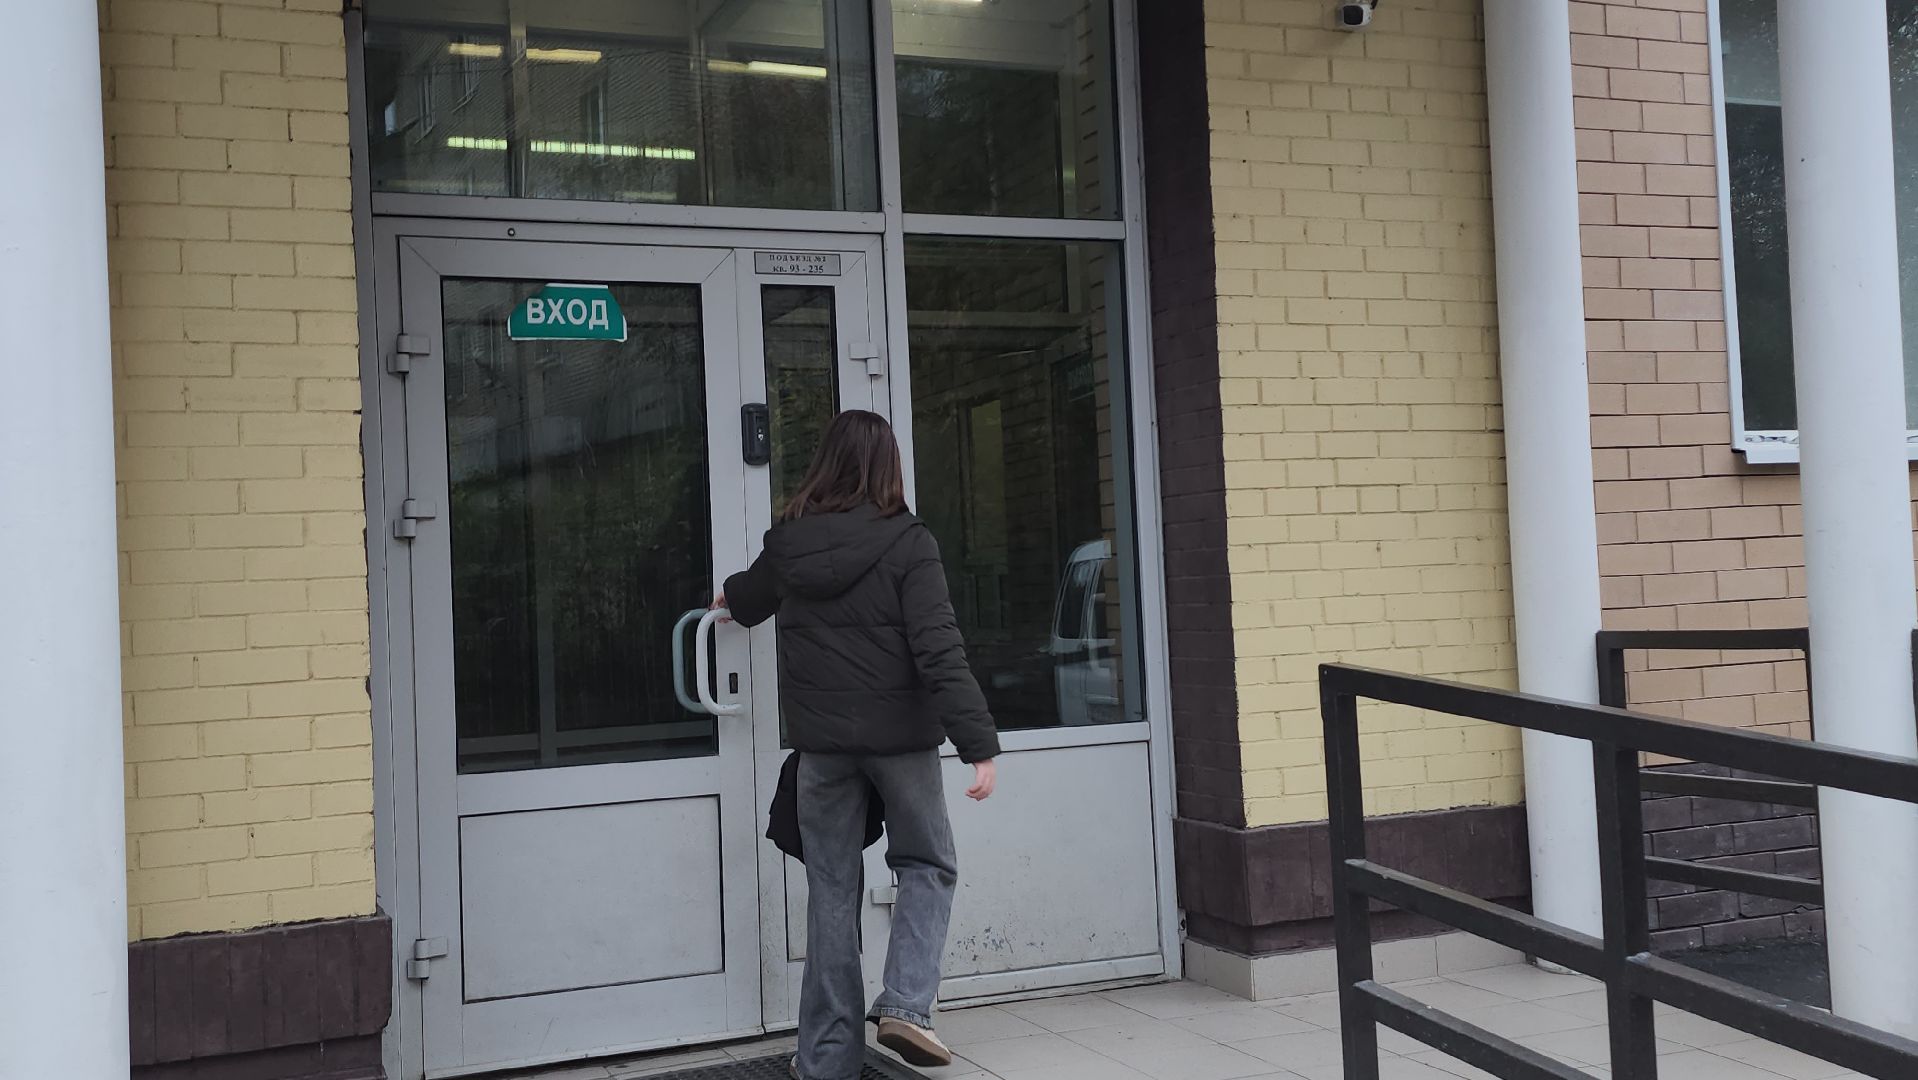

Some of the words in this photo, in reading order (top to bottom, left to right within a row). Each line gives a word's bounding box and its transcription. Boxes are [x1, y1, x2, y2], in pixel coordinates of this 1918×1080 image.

[769, 254, 811, 262] ПОДЪЕЗД
[808, 264, 824, 273] 235
[526, 298, 609, 331] ВХОД
